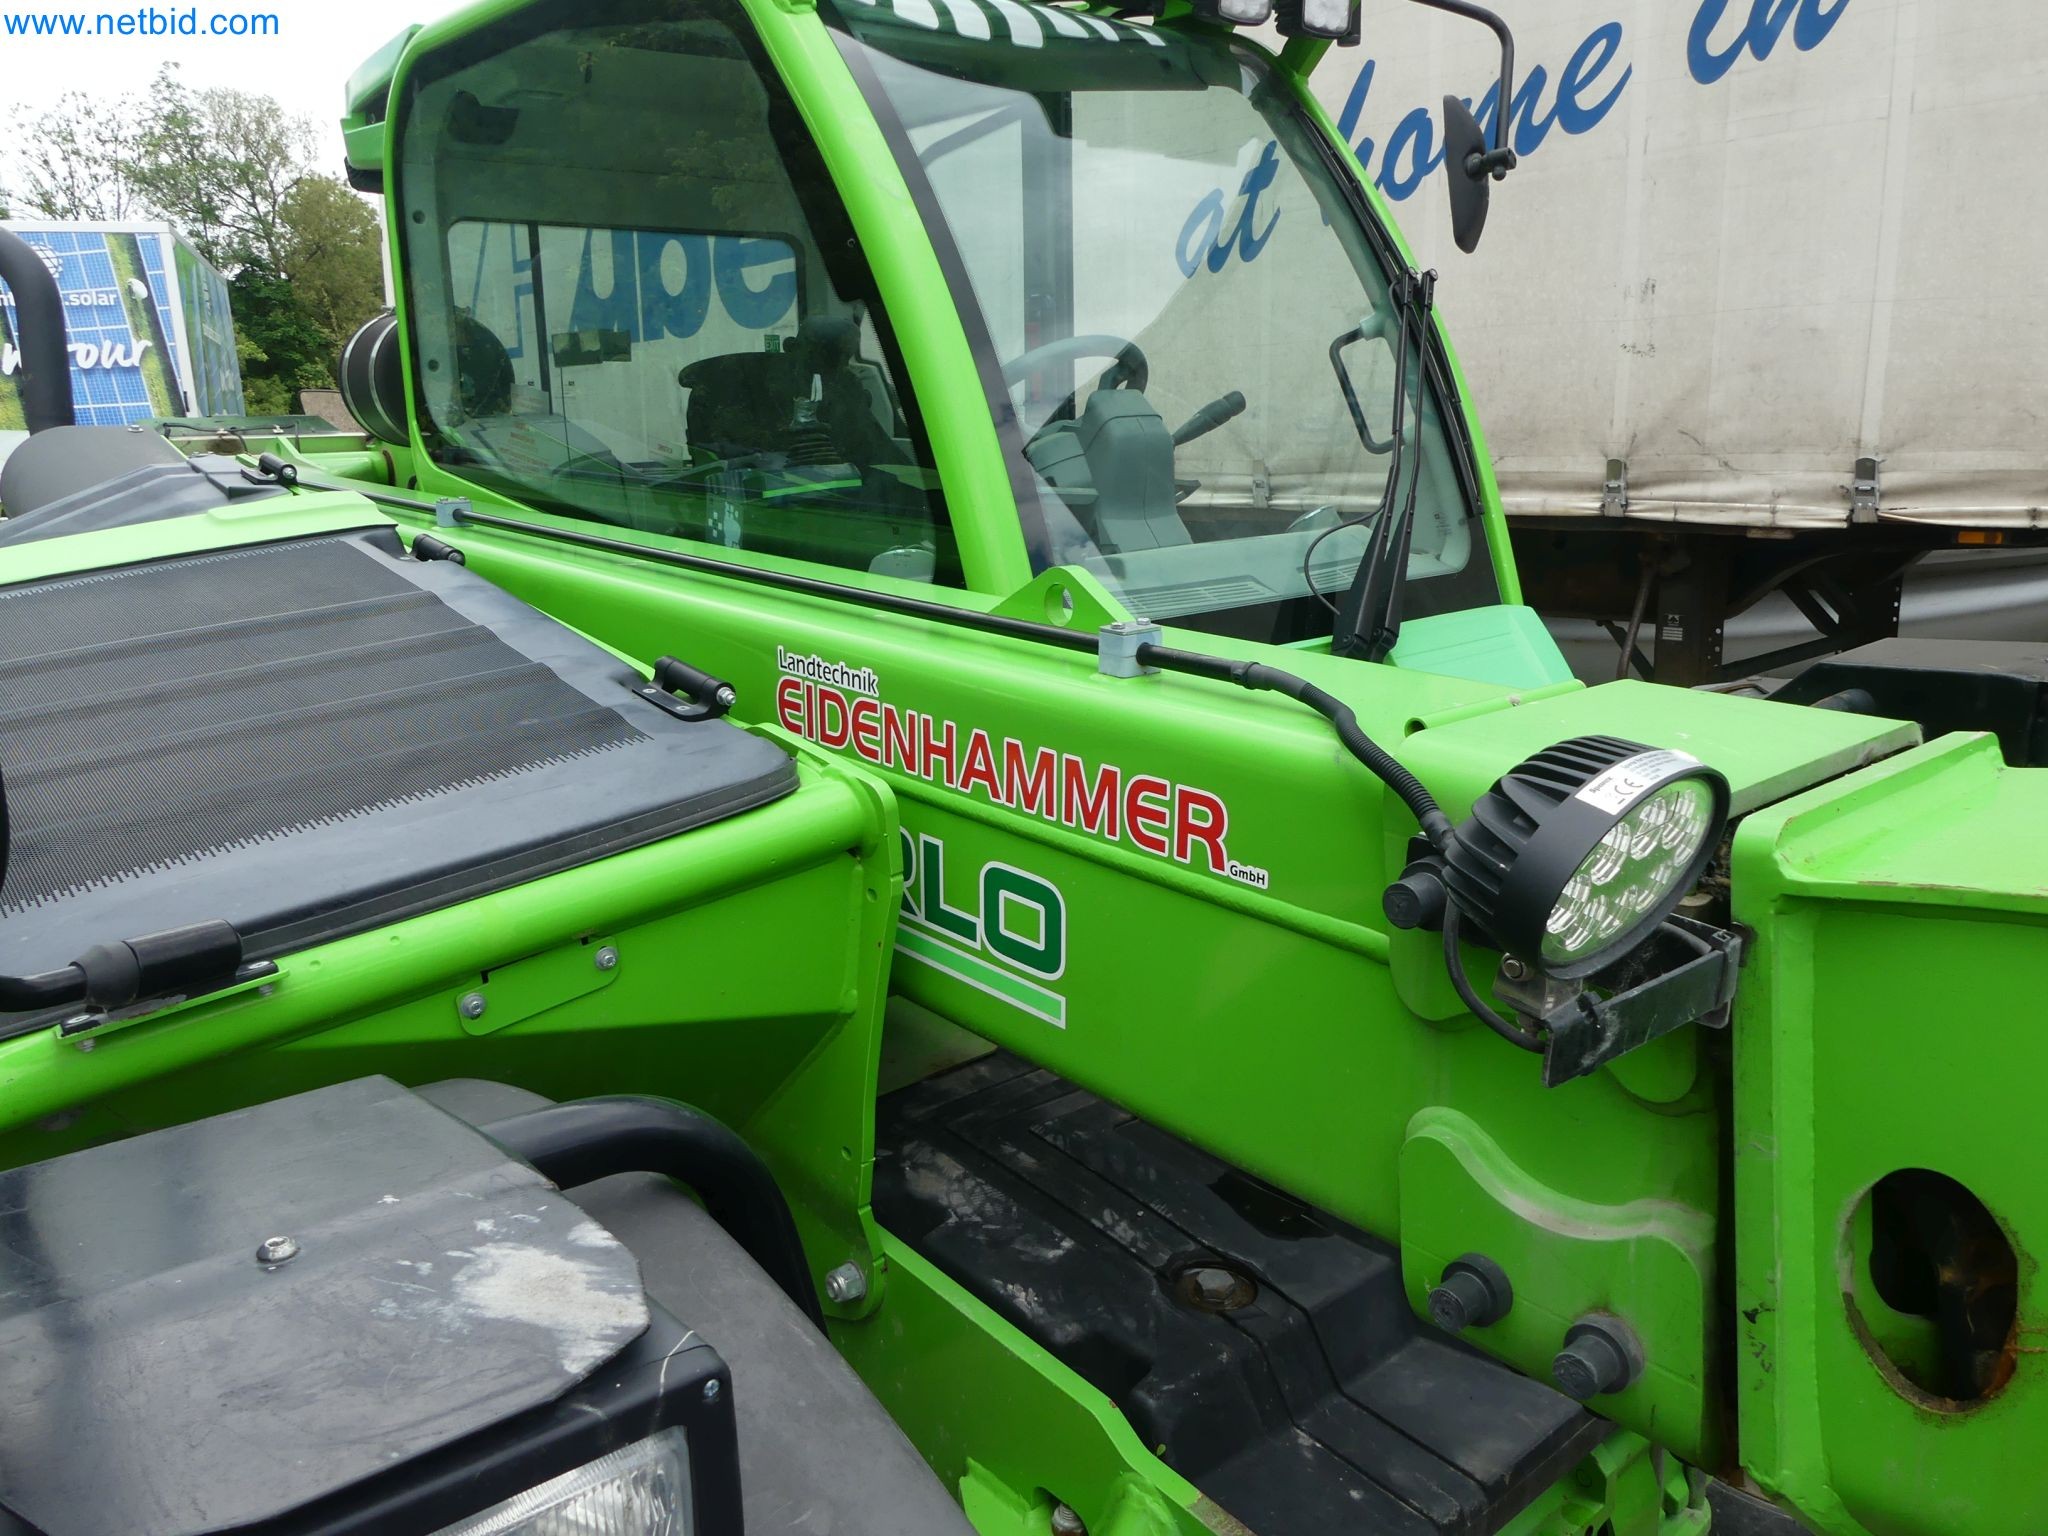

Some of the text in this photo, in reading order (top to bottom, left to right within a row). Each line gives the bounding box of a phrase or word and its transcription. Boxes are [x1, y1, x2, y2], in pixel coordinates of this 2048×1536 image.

[1175, 140, 1281, 280] at
[779, 647, 879, 695] Landtechnik
[777, 678, 1266, 886] EIDENHAMMER GmbH
